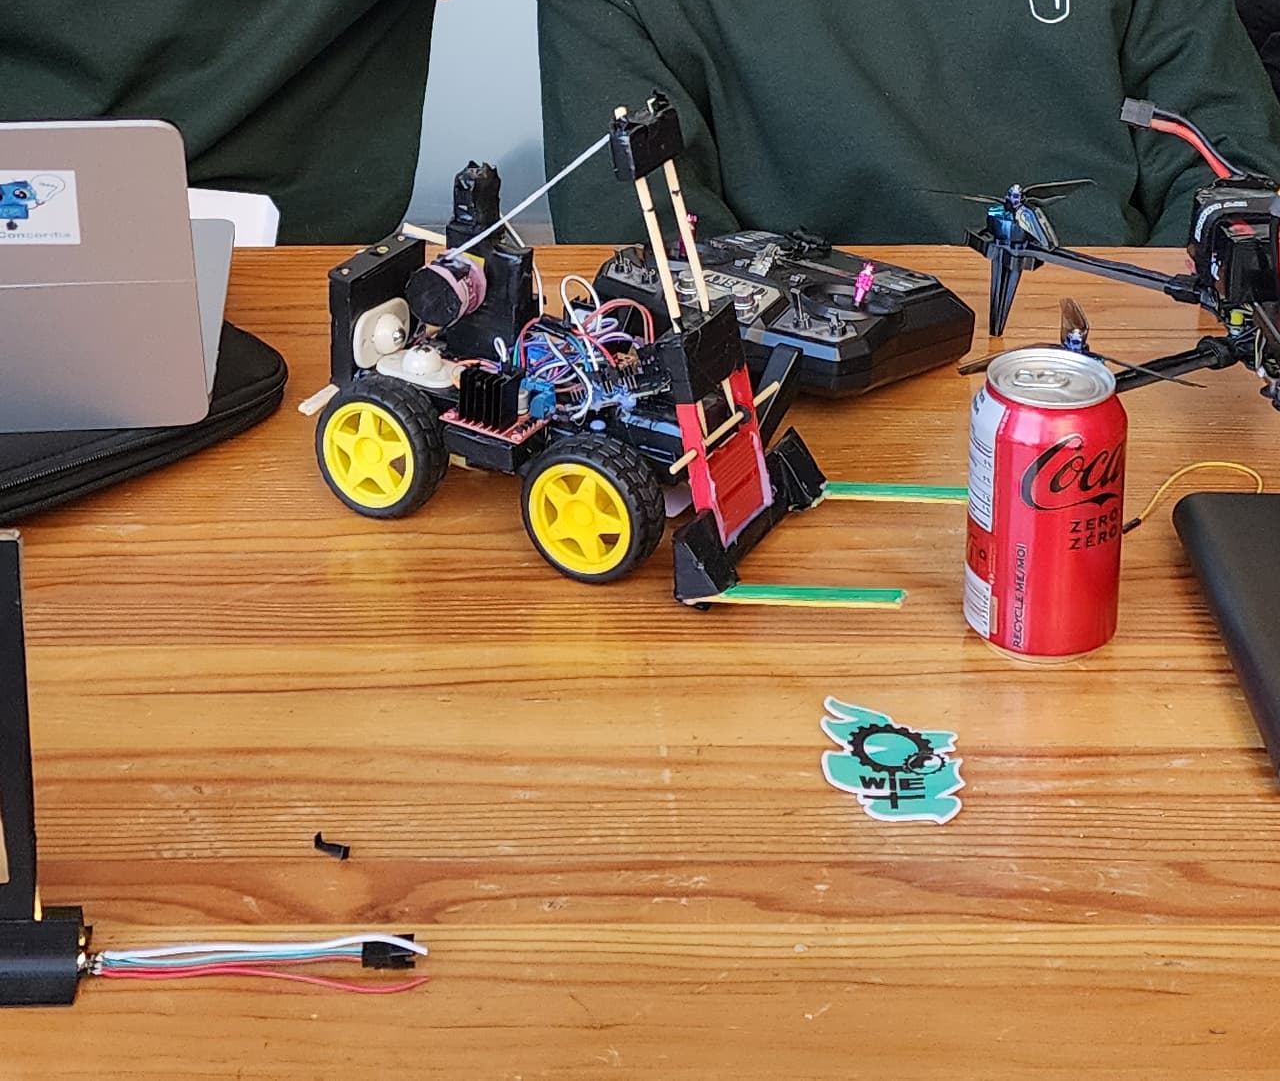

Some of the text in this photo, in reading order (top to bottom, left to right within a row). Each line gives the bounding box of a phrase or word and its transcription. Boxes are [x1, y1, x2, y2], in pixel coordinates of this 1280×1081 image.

[1021, 432, 1122, 511] Coca
[1070, 508, 1119, 534] ZERO
[1013, 596, 1025, 648] RECYCLE
